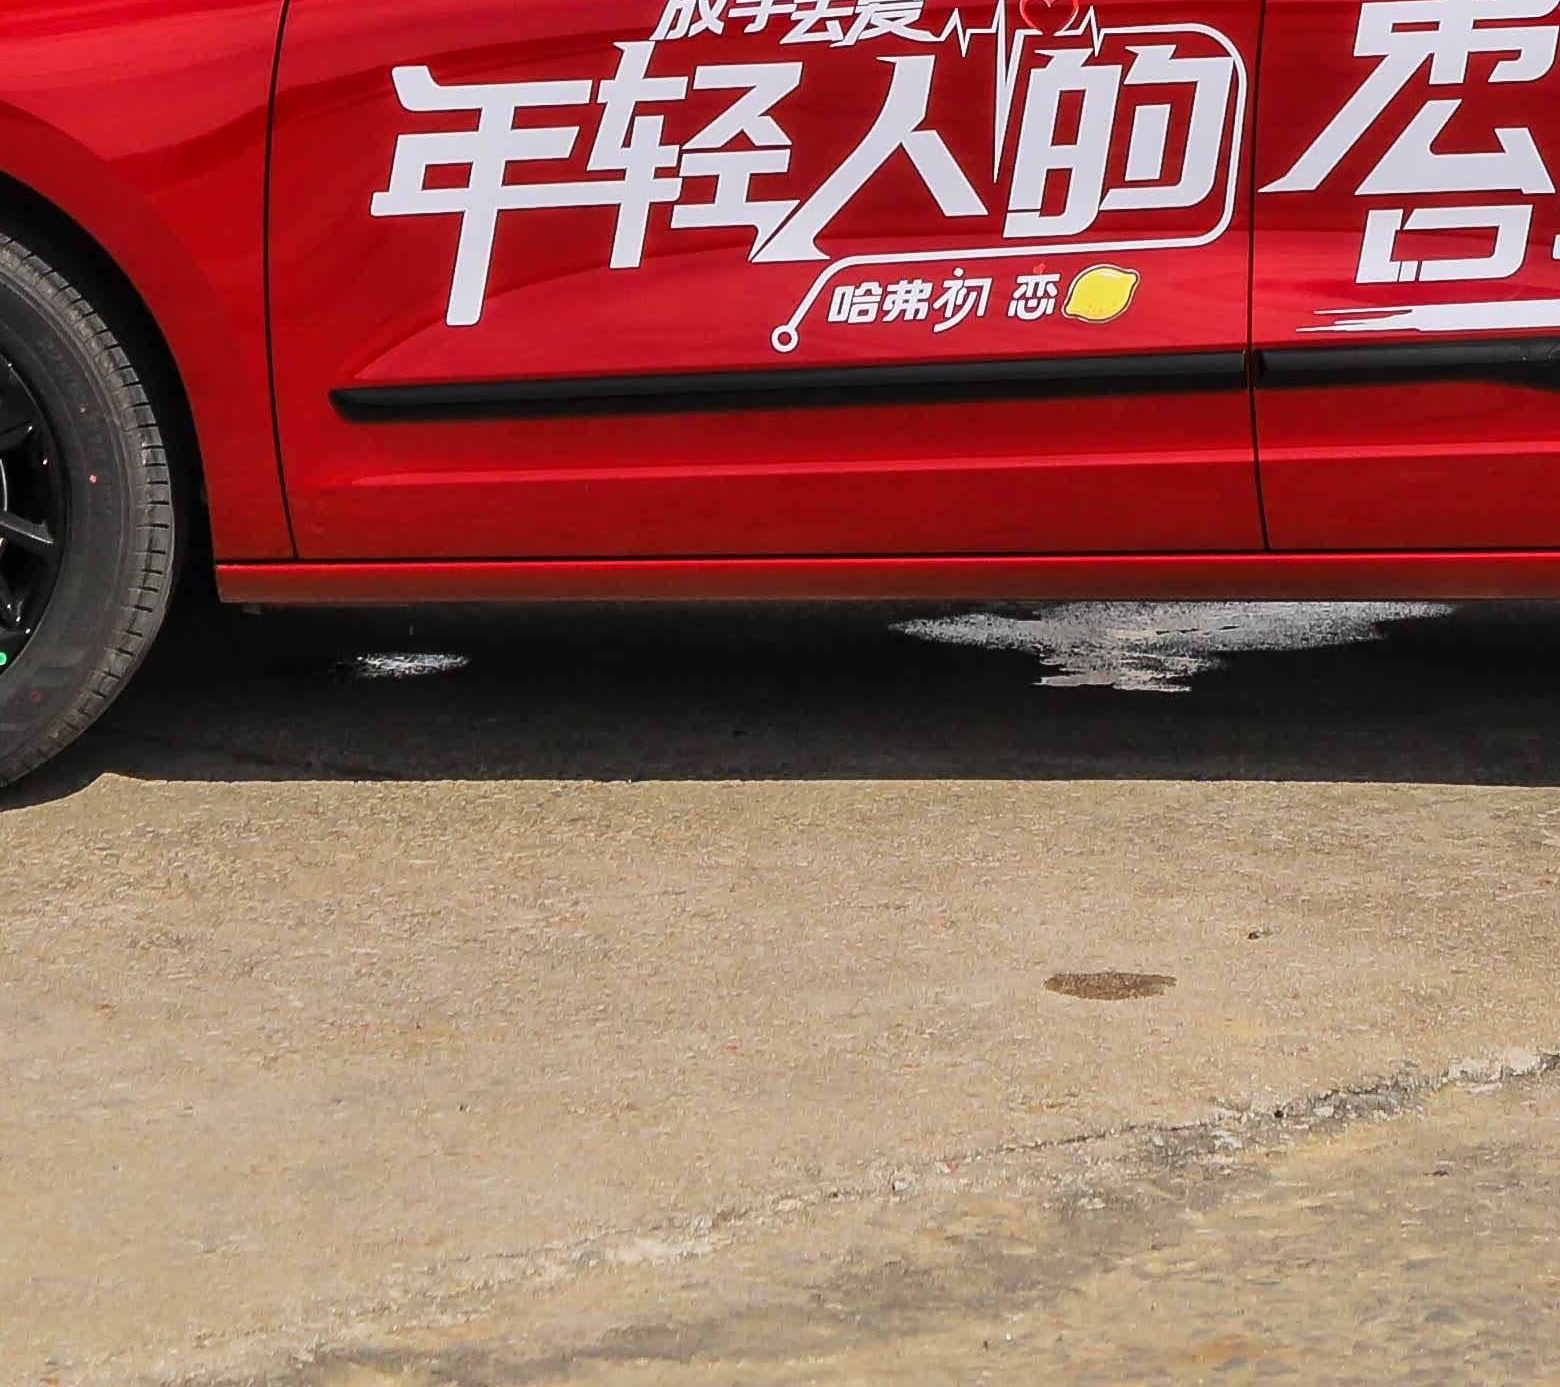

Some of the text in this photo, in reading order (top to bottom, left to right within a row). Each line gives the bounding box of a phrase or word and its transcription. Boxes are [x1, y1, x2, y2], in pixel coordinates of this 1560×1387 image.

[370, 41, 1236, 327] 年轻人的
[827, 265, 1061, 332] 哈弗初恋
